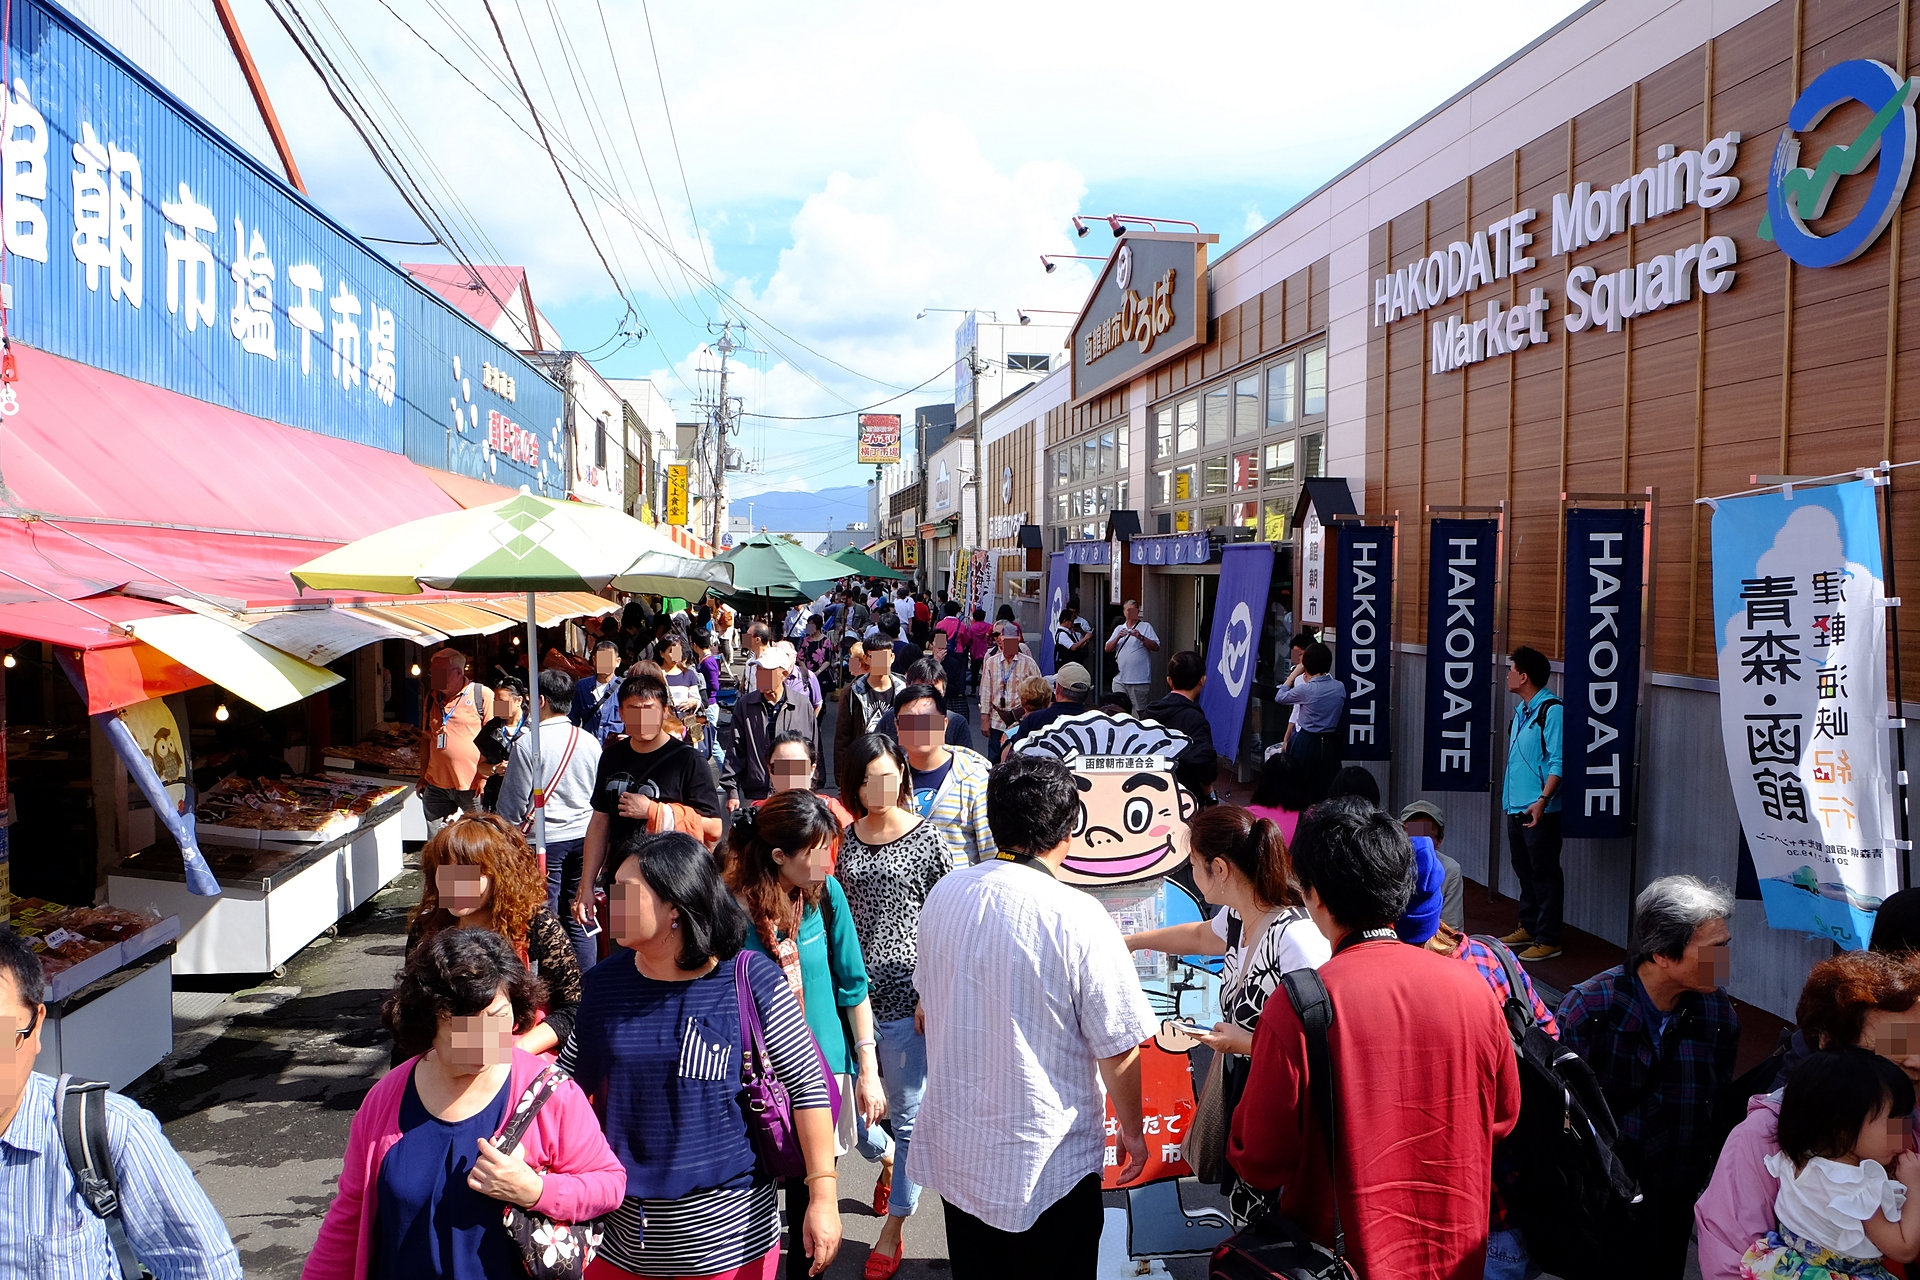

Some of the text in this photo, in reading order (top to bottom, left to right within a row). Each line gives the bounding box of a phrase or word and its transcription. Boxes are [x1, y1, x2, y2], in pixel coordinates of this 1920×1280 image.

[1374, 130, 1741, 328] HAKODATE Morning
[1431, 235, 1737, 375] Market Square
[861, 434, 897, 444] どんぶり
[861, 447, 899, 457] 横丁市場
[1308, 514, 1319, 616] 函館朝市
[1348, 542, 1378, 745] HAKODATE
[1440, 538, 1478, 773] HAKODATE
[1584, 532, 1623, 817] HAKODATE
[1085, 757, 1154, 770] 函館朝市連合会
[1362, 927, 1398, 939] Canon
[1104, 1113, 1181, 1136] はだて
